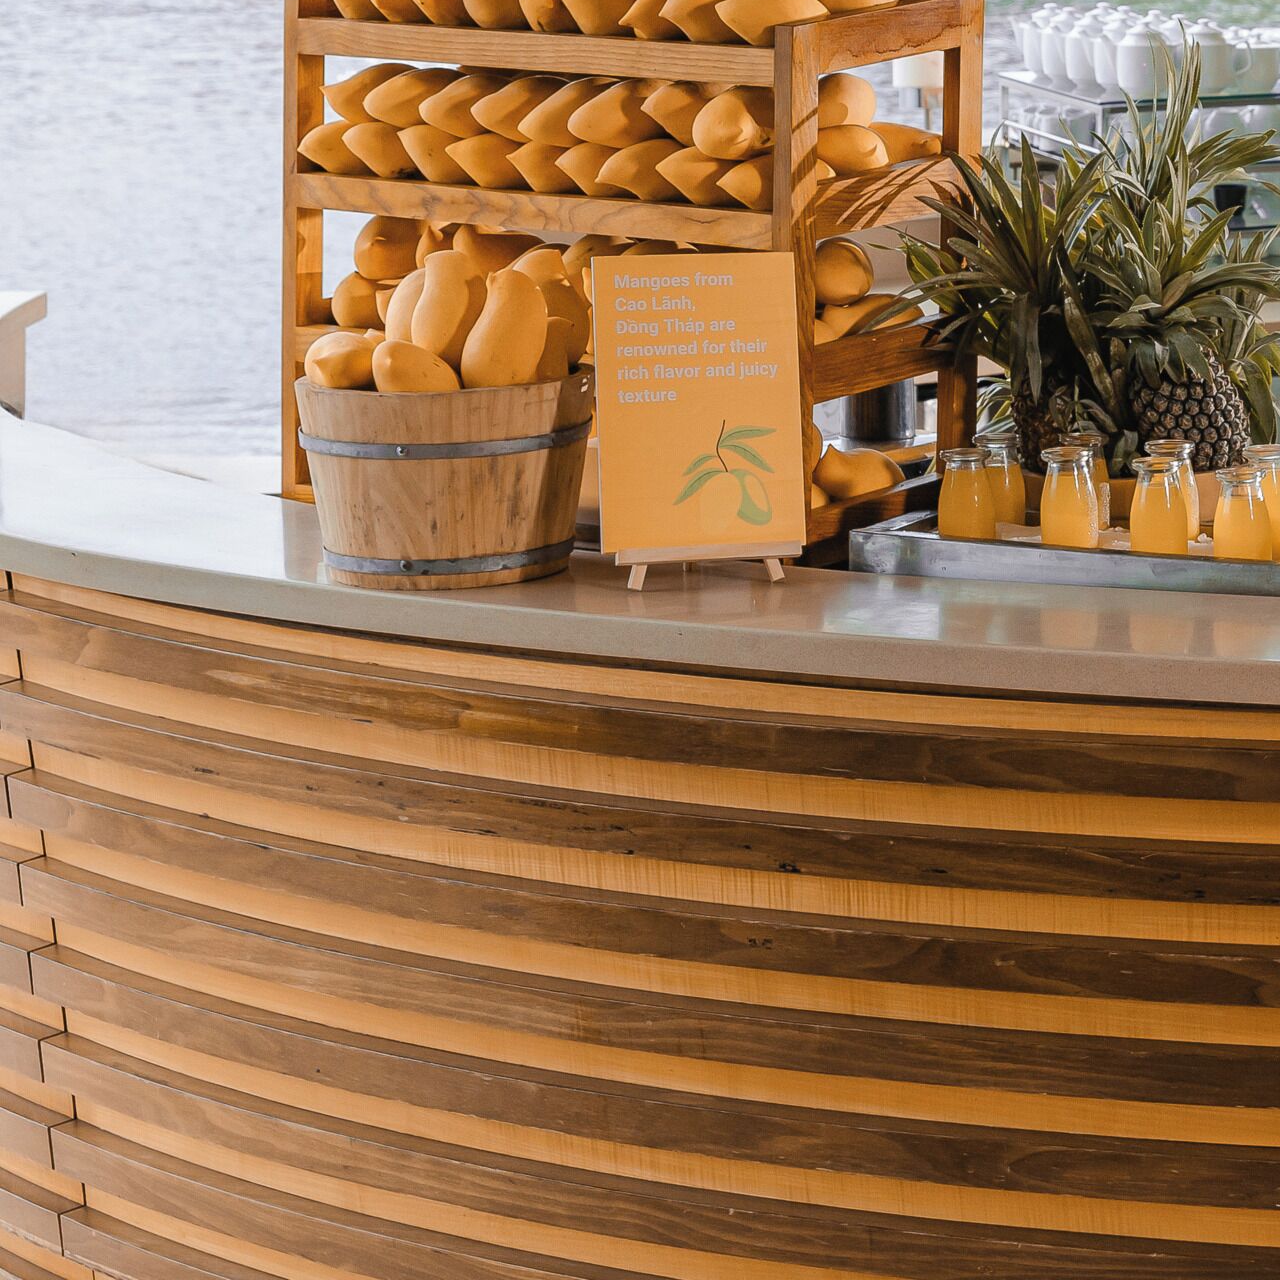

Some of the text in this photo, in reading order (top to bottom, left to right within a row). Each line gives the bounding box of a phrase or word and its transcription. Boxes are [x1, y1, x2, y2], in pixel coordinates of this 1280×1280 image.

[614, 272, 733, 291] Mangoes from
[615, 297, 647, 311] Cao
[664, 318, 705, 335] Tháp
[710, 320, 736, 331] are
[616, 339, 768, 357] renowned for their
[617, 362, 778, 380] rich flavor and juicy
[618, 390, 677, 403] texture
